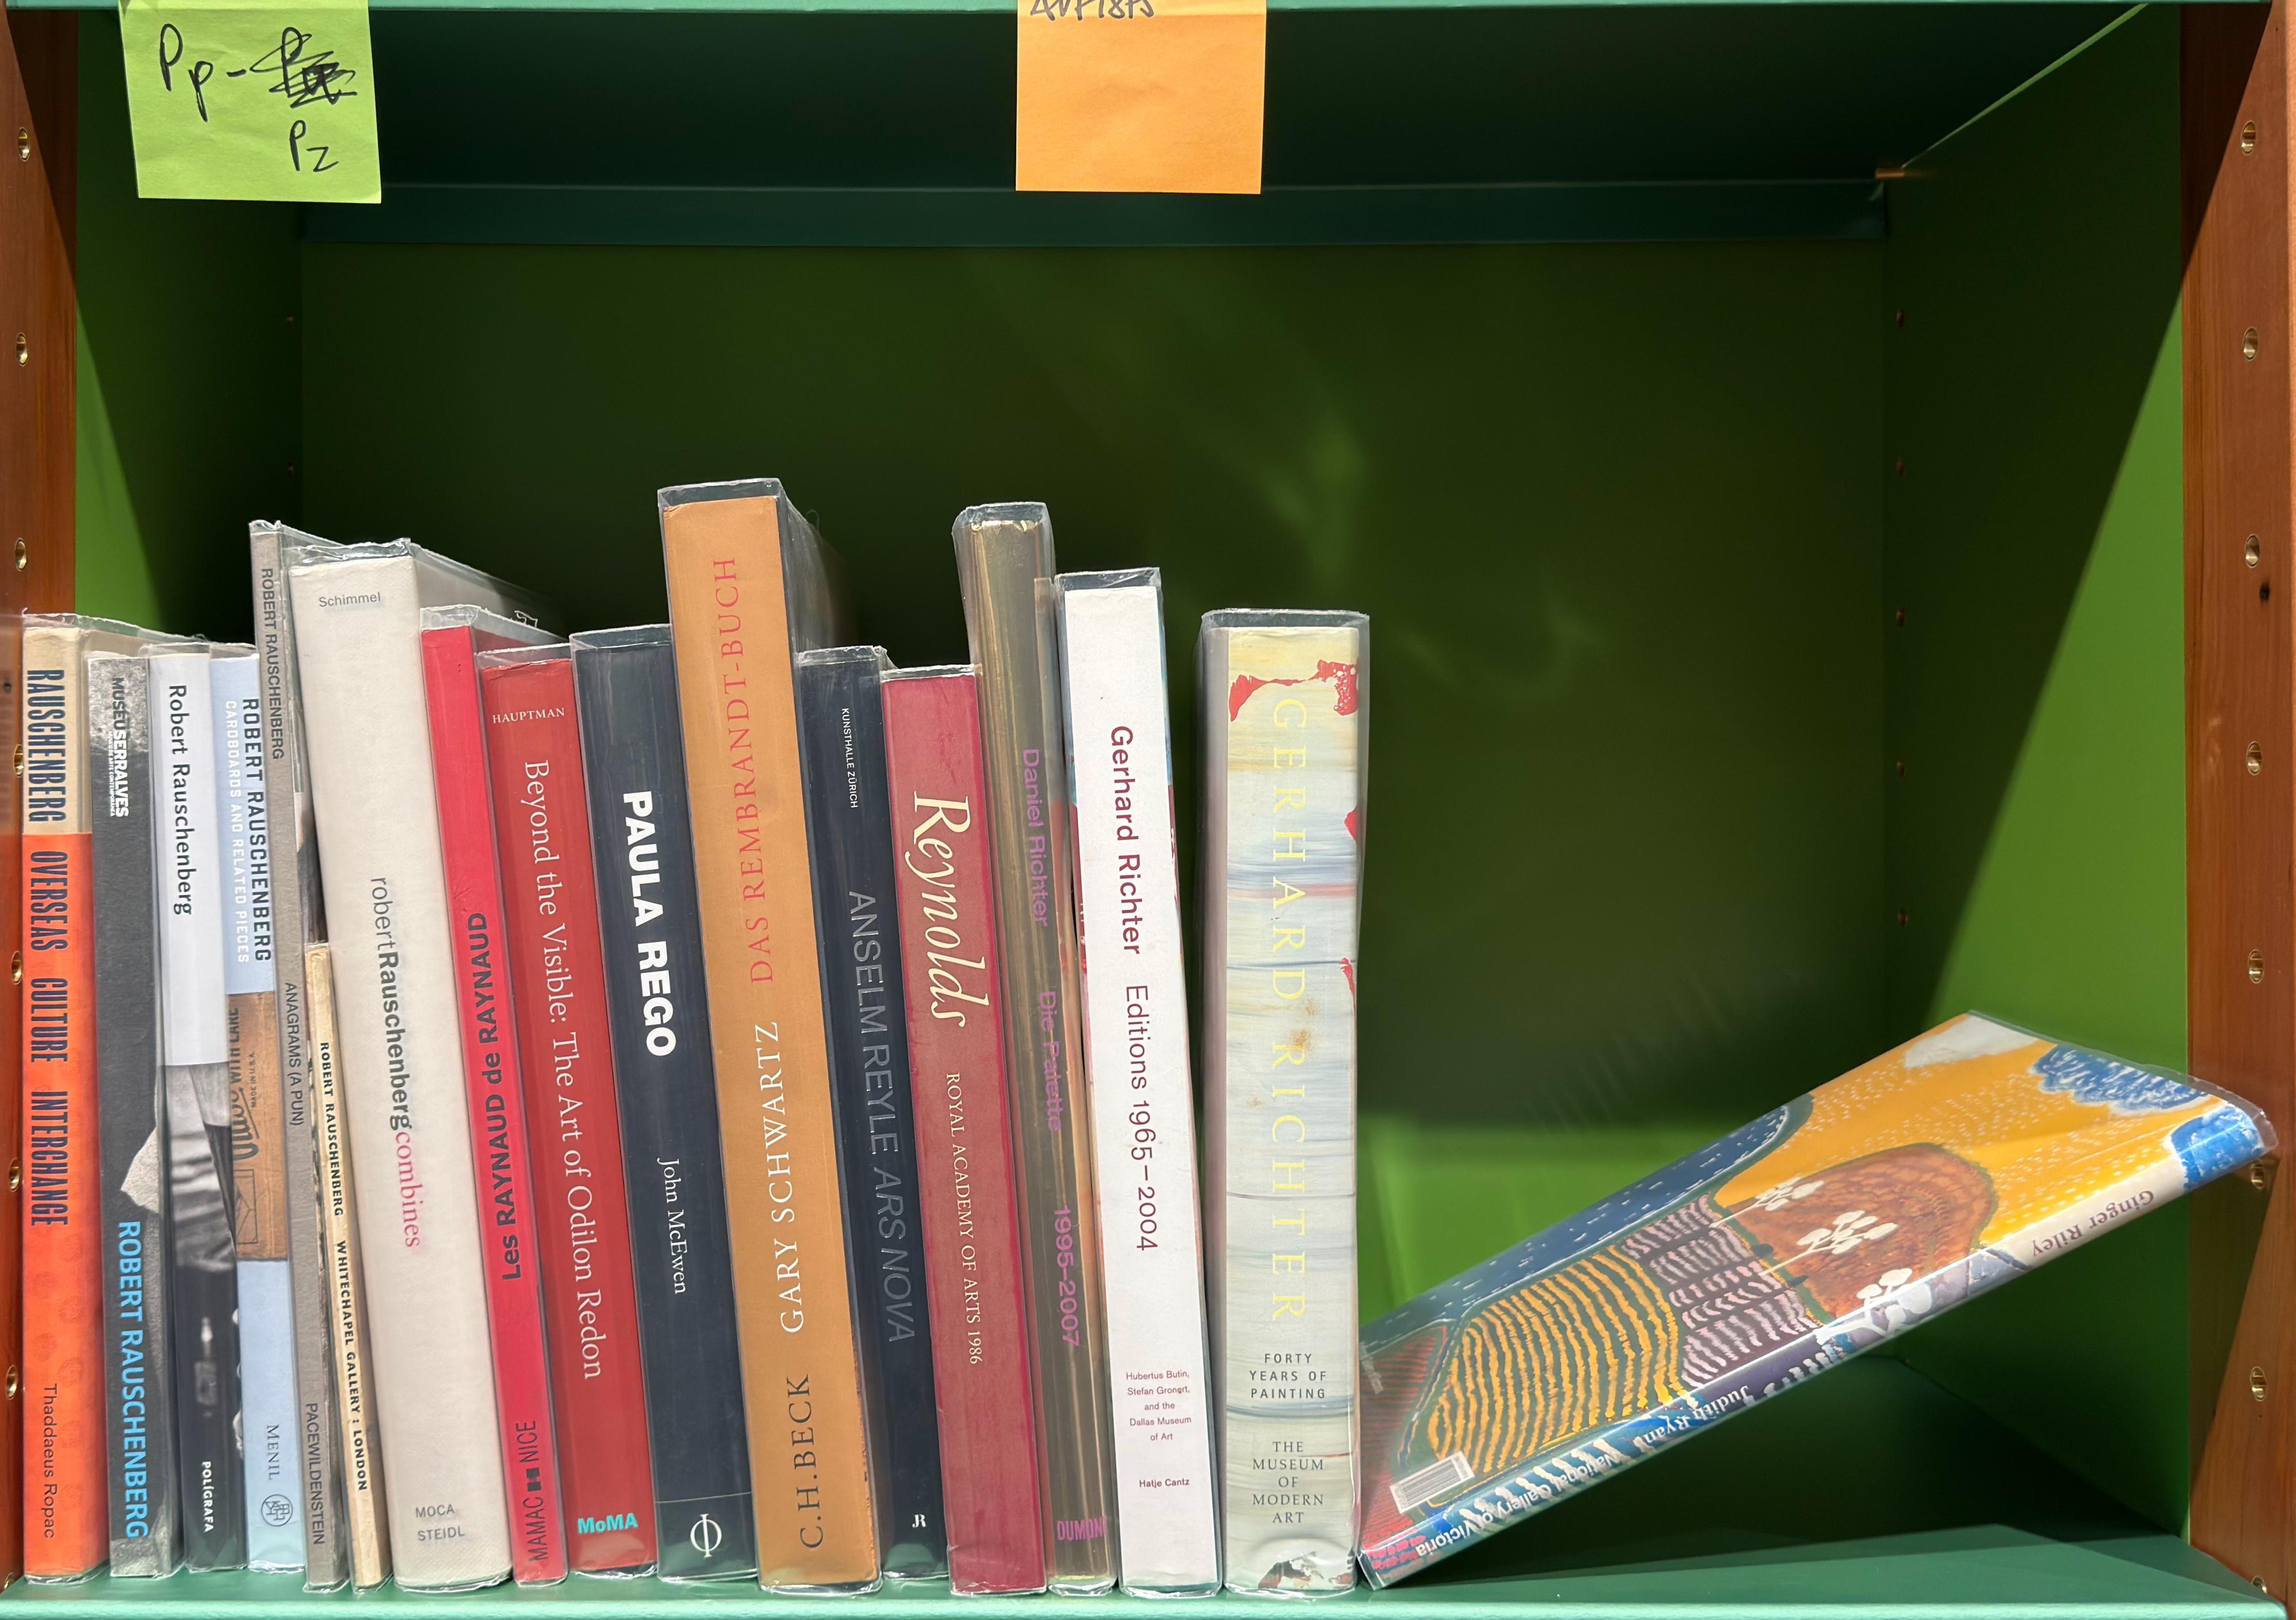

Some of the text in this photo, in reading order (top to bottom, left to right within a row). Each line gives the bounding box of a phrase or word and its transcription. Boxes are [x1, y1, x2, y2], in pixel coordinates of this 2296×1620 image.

[319, 592, 381, 607] Schimmel
[261, 568, 284, 759] ROBERT RAUSCHENBERG
[492, 708, 565, 723] HAUPTMAN
[27, 670, 66, 822] RAUSCHENBERG
[714, 558, 772, 983] DAS REMBRANDT-BUCH
[842, 708, 858, 808] KUNSTHALLE ZÜRICH
[169, 685, 196, 915] Robert Rauschenberg
[225, 701, 249, 963] CARDBOARDS AND RELATED PIECES
[243, 698, 272, 961] ROBERT RAUSCHENBERG
[1023, 750, 1048, 927] Daniel Richter
[1111, 727, 1142, 954] Gerhard Richter
[624, 791, 676, 1055] PAULA REGO
[905, 791, 989, 1028] Reynolds
[30, 851, 68, 1226] OVERSEAS CULTURE INTERCHANGE
[286, 982, 304, 1125] ANAGRAMS (A PUN)
[1040, 991, 1063, 1132] Die Palette
[1126, 986, 1151, 1089] Editions
[1272, 698, 1307, 1321] GERHARD RICHTER
[320, 1042, 333, 1096] ROBERT
[468, 914, 521, 1280] Les RAYNAUD de RAYNAUD
[521, 760, 606, 1379] Beyond the Visible: The Art of Odilon Redon
[849, 891, 915, 1341] ANSELM REYLE ARS NOVA
[325, 1104, 343, 1216] RAUSCHENBERG
[755, 1022, 804, 1332] GARY SCHWARTZ
[657, 1158, 687, 1294] John McEwen
[947, 1073, 983, 1364] ROYAL ACADEMY OF ARTS 1986
[2032, 1190, 2153, 1256] Ginger Riley
[336, 1240, 353, 1345] WHITECHAPEL
[118, 1221, 148, 1538] ROBERT RAUSCHENBERG
[346, 1353, 361, 1413] GALLERY
[1126, 1371, 1163, 1380] Hubertus
[1249, 1371, 1326, 1381] YEARS OF
[1251, 1388, 1325, 1398] PAINTING
[1264, 1353, 1312, 1364] FORTY
[41, 1383, 57, 1538] Thaddaeus Ropac
[266, 1424, 280, 1480] MENIL
[353, 1430, 367, 1491] LONDON
[1252, 1459, 1323, 1470] MUSEUM
[1273, 1441, 1304, 1452] THE
[1644, 1385, 1749, 1444] Judith Ryan
[202, 1461, 214, 1533] POLÍGRAFA
[306, 1403, 324, 1544] PACEWILDENSTEIN
[416, 1503, 455, 1518] MOCA
[516, 1420, 548, 1562] MAMAC NICE
[578, 1513, 638, 1534] MoMA
[1139, 1479, 1162, 1488] Hatje
[1252, 1494, 1323, 1505] MODERN
[1272, 1512, 1304, 1523] ART
[1278, 1477, 1299, 1488] OF
[418, 1526, 465, 1541] STEIDL
[1416, 1520, 1481, 1556] Victoria
